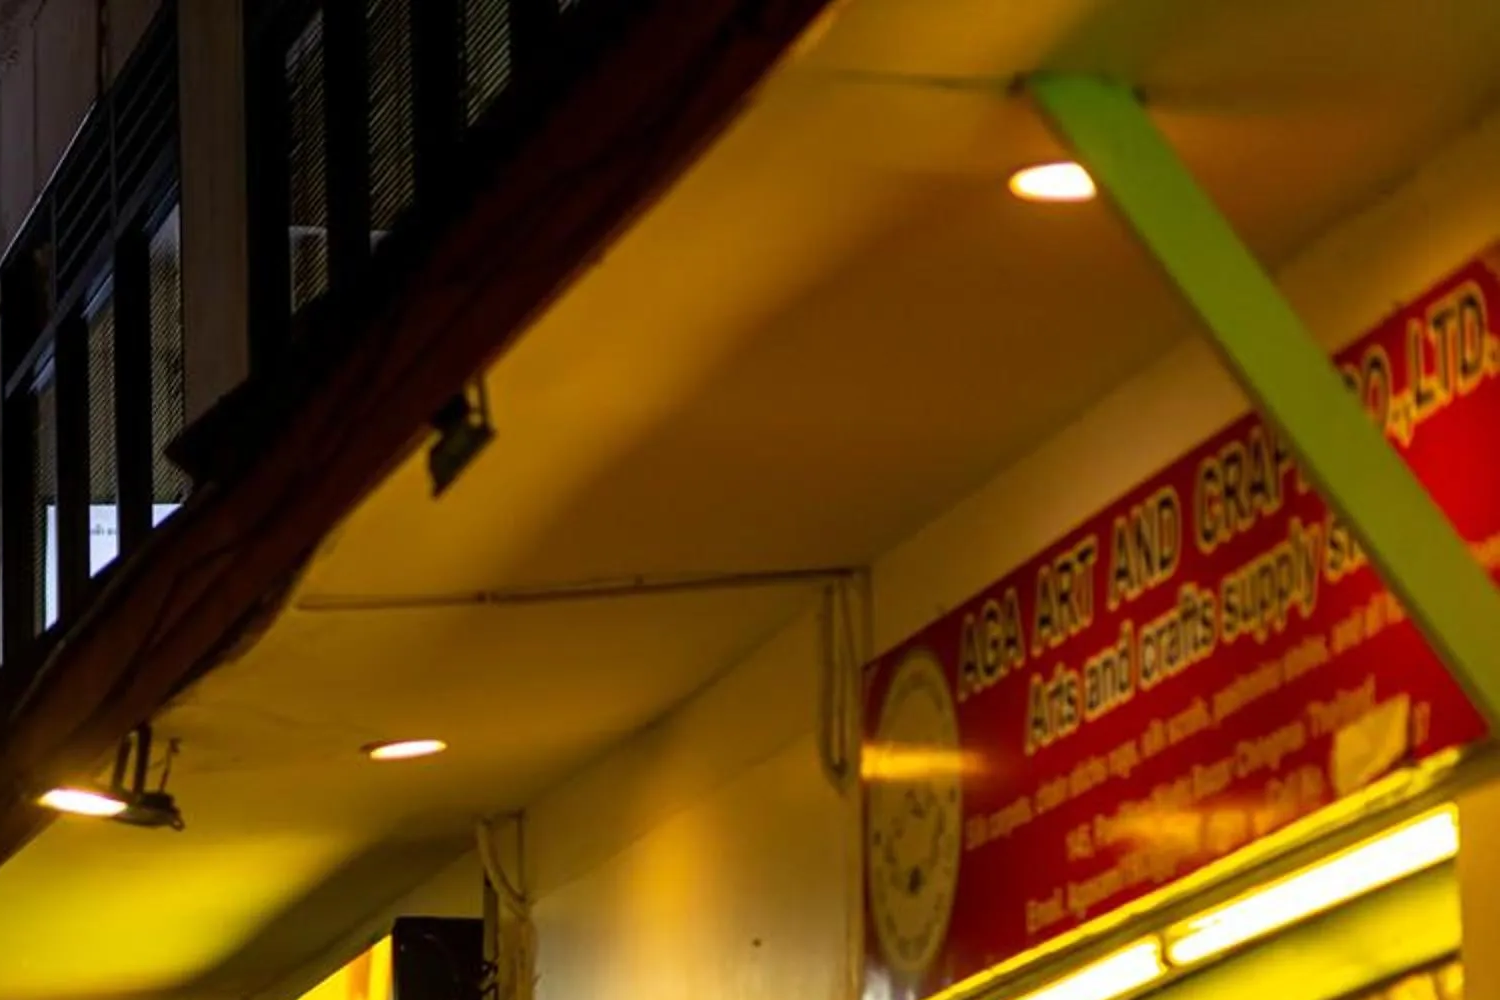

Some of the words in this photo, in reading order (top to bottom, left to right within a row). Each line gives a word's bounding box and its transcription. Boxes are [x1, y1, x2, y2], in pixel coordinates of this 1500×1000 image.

[957, 587, 1025, 698] AGA
[1031, 534, 1100, 658] ART
[1107, 484, 1181, 611] AND
[1027, 668, 1080, 756] Arts
[1084, 620, 1136, 721] and
[1139, 580, 1216, 690] crafts
[1219, 518, 1321, 644] supply
